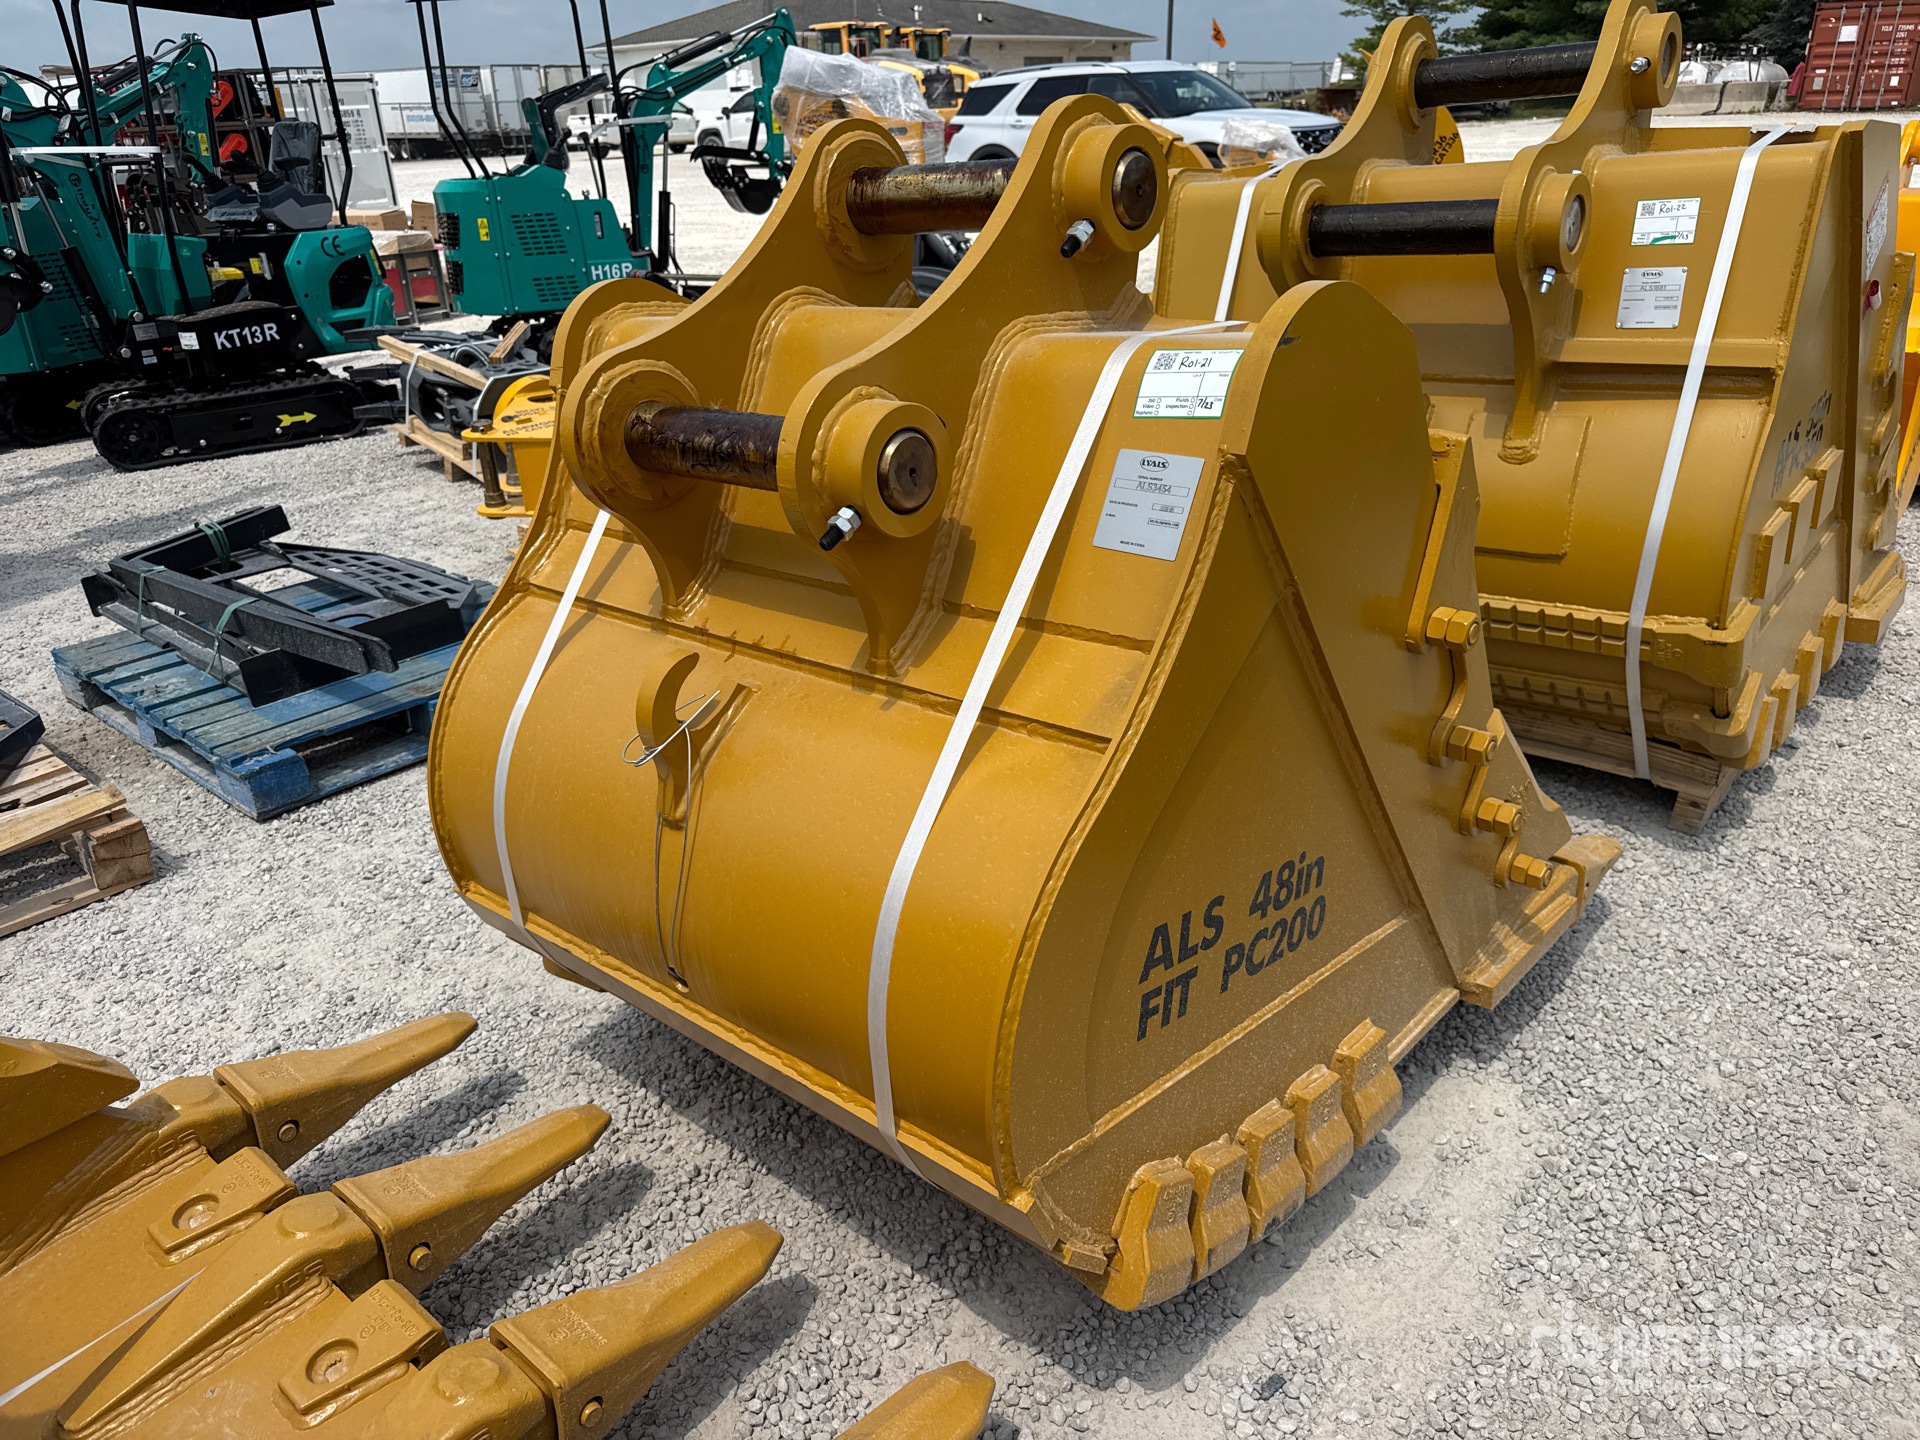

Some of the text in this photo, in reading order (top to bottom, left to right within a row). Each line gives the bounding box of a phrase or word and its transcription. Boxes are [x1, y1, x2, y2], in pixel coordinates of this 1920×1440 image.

[214, 323, 280, 350] KT13R
[1197, 396, 1214, 410] 7/23
[1141, 459, 1168, 469] LYALS
[1136, 481, 1172, 494] ALS3454
[1138, 851, 1325, 985] ALS 48in
[1137, 895, 1326, 1042] FIT PC200
